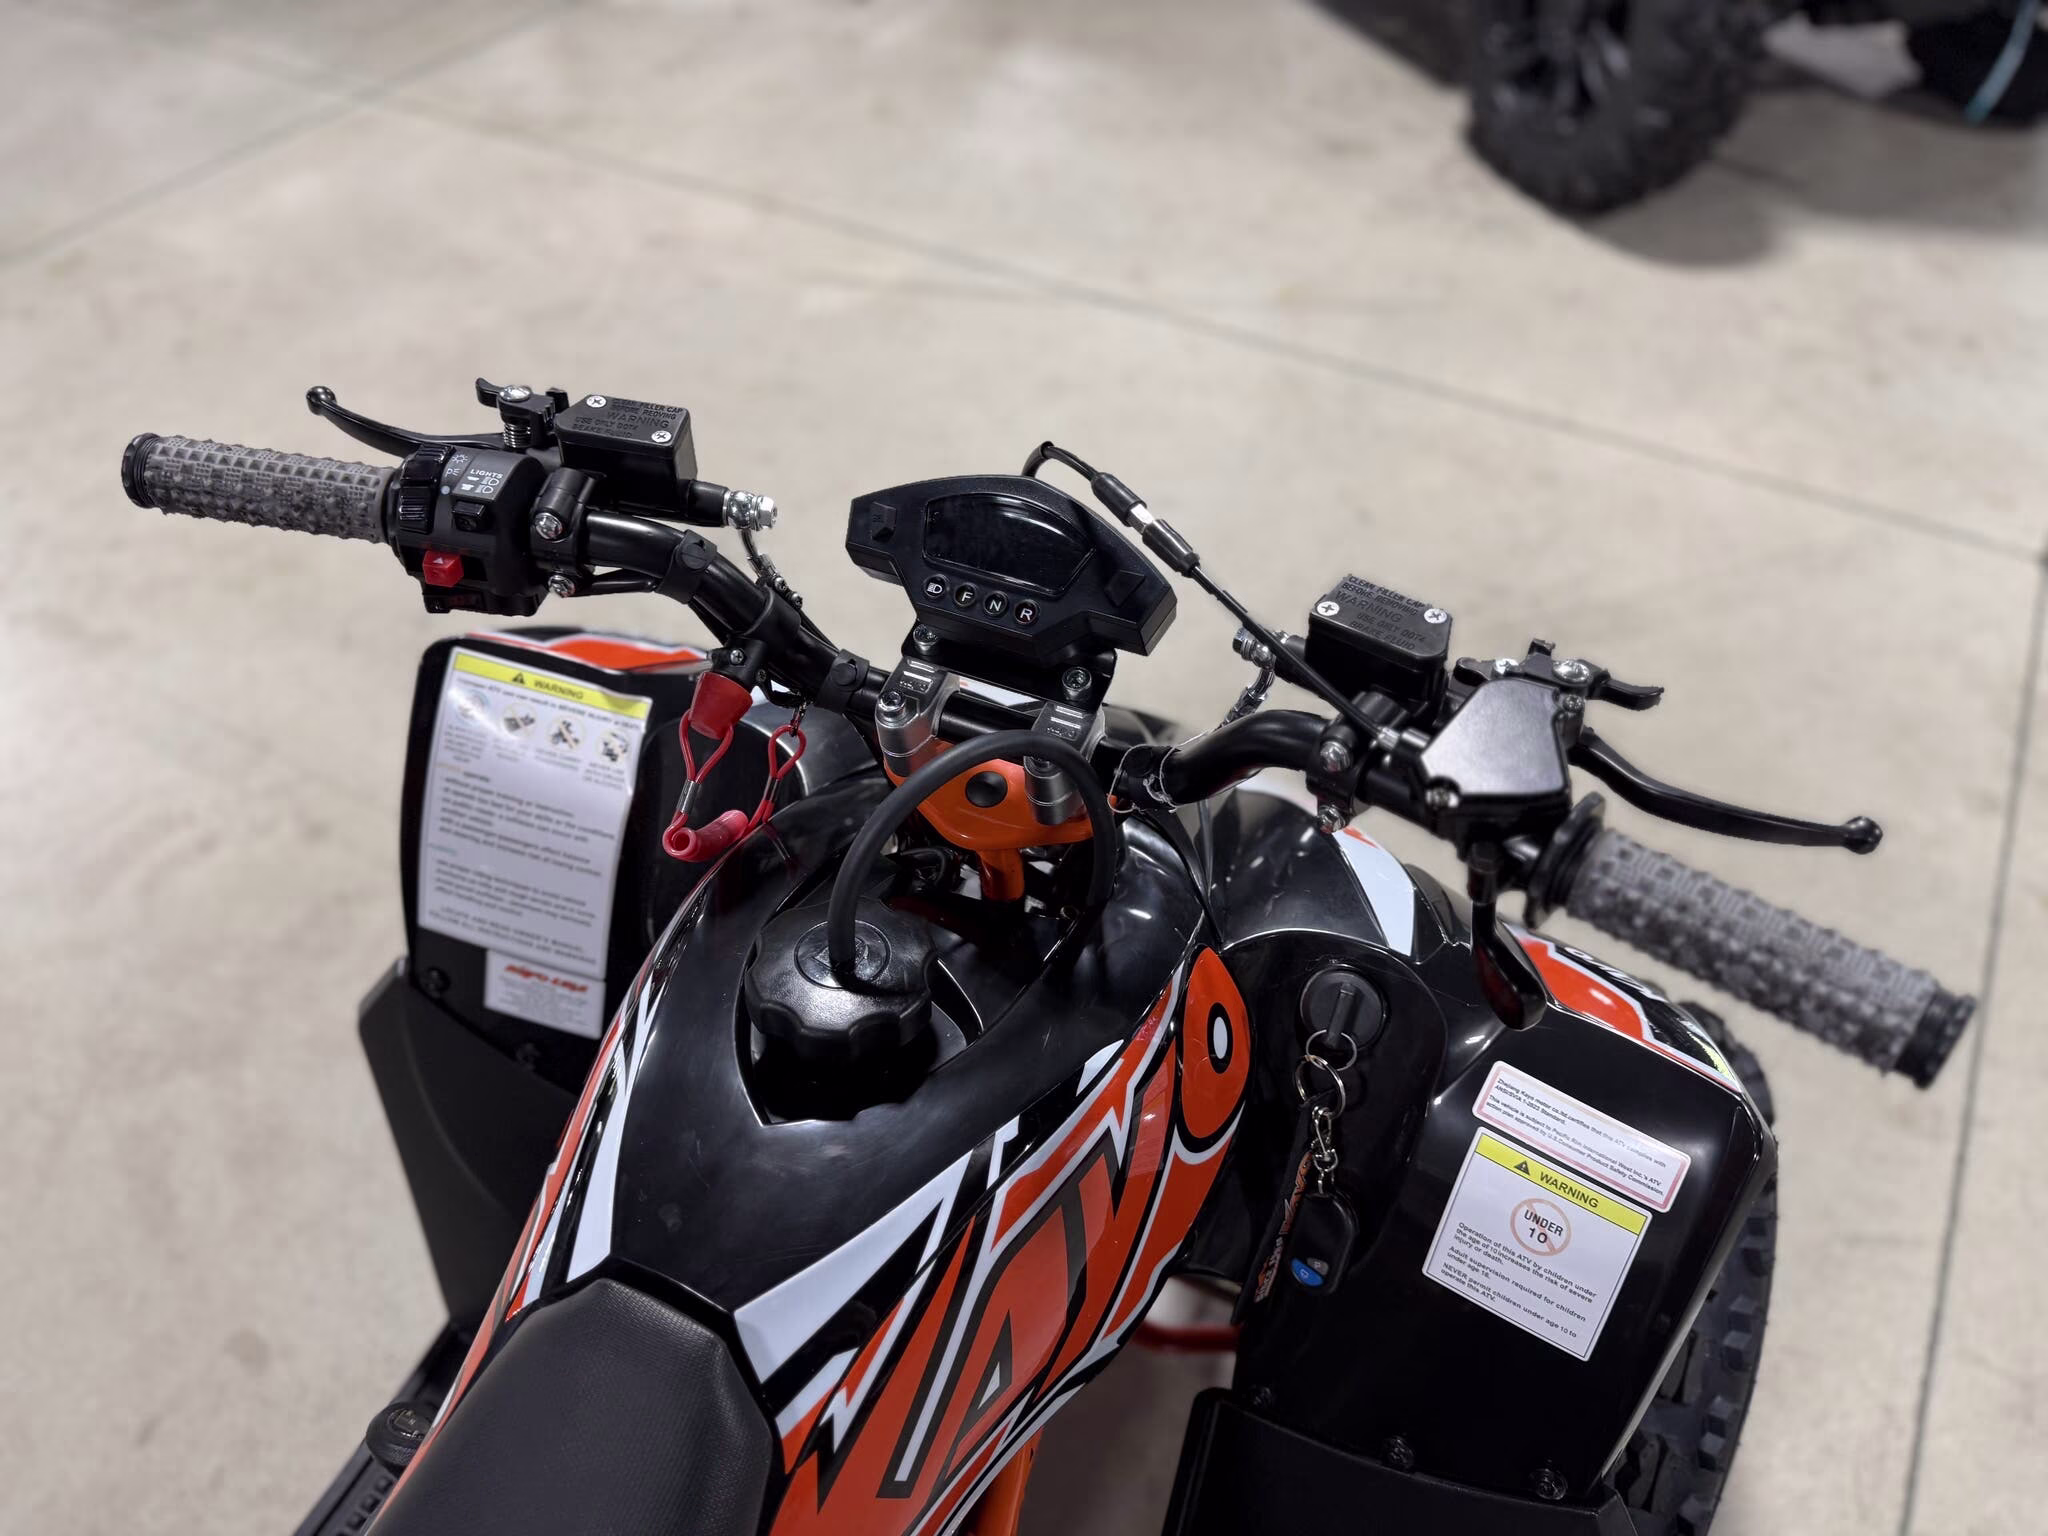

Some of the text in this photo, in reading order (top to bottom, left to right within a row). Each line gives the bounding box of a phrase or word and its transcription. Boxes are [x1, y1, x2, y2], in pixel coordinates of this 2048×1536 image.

[608, 412, 670, 428] WARNING
[470, 469, 503, 479] LIGHTS
[961, 591, 1033, 620] F N R
[1336, 591, 1402, 623] WARNING
[1350, 620, 1416, 650] BRAKE FLUID
[1356, 612, 1375, 625] USE
[1377, 621, 1399, 633] ONLY
[533, 680, 582, 699] WARNING
[1535, 1098, 1551, 1109] motor
[1488, 1095, 1500, 1104] This
[1501, 1101, 1519, 1114] vehicle
[1525, 1114, 1545, 1128] subject
[1648, 1177, 1660, 1186] ATV
[1586, 1153, 1609, 1168] Product
[1609, 1164, 1626, 1178] Safety
[1538, 1172, 1599, 1208] WARNING
[1523, 1210, 1563, 1236] UNDER
[1527, 1226, 1548, 1244] 10
[1447, 1252, 1466, 1265] under
[1467, 1263, 1479, 1273] age
[1453, 1234, 1472, 1248] injury
[1483, 1250, 1504, 1264] death.
[1458, 1222, 1491, 1244] Operation
[1502, 1245, 1515, 1256] this
[1516, 1253, 1530, 1264] ATV
[1532, 1262, 1541, 1271] by
[1543, 1267, 1572, 1286] children
[1574, 1284, 1595, 1298] under
[1456, 1228, 1466, 1237] the
[1468, 1235, 1480, 1245] age
[1532, 1268, 1543, 1278] the
[1544, 1275, 1558, 1285] risk
[1568, 1288, 1592, 1303] severe
[1440, 1268, 1465, 1286] operate
[1467, 1282, 1479, 1293] this
[1449, 1246, 1585, 1322] Adult supervision required for children
[1443, 1262, 1467, 1279] NEVER
[1468, 1276, 1491, 1293] permit
[1492, 1289, 1521, 1308] children
[1523, 1306, 1544, 1320] under
[1545, 1318, 1558, 1329] age
